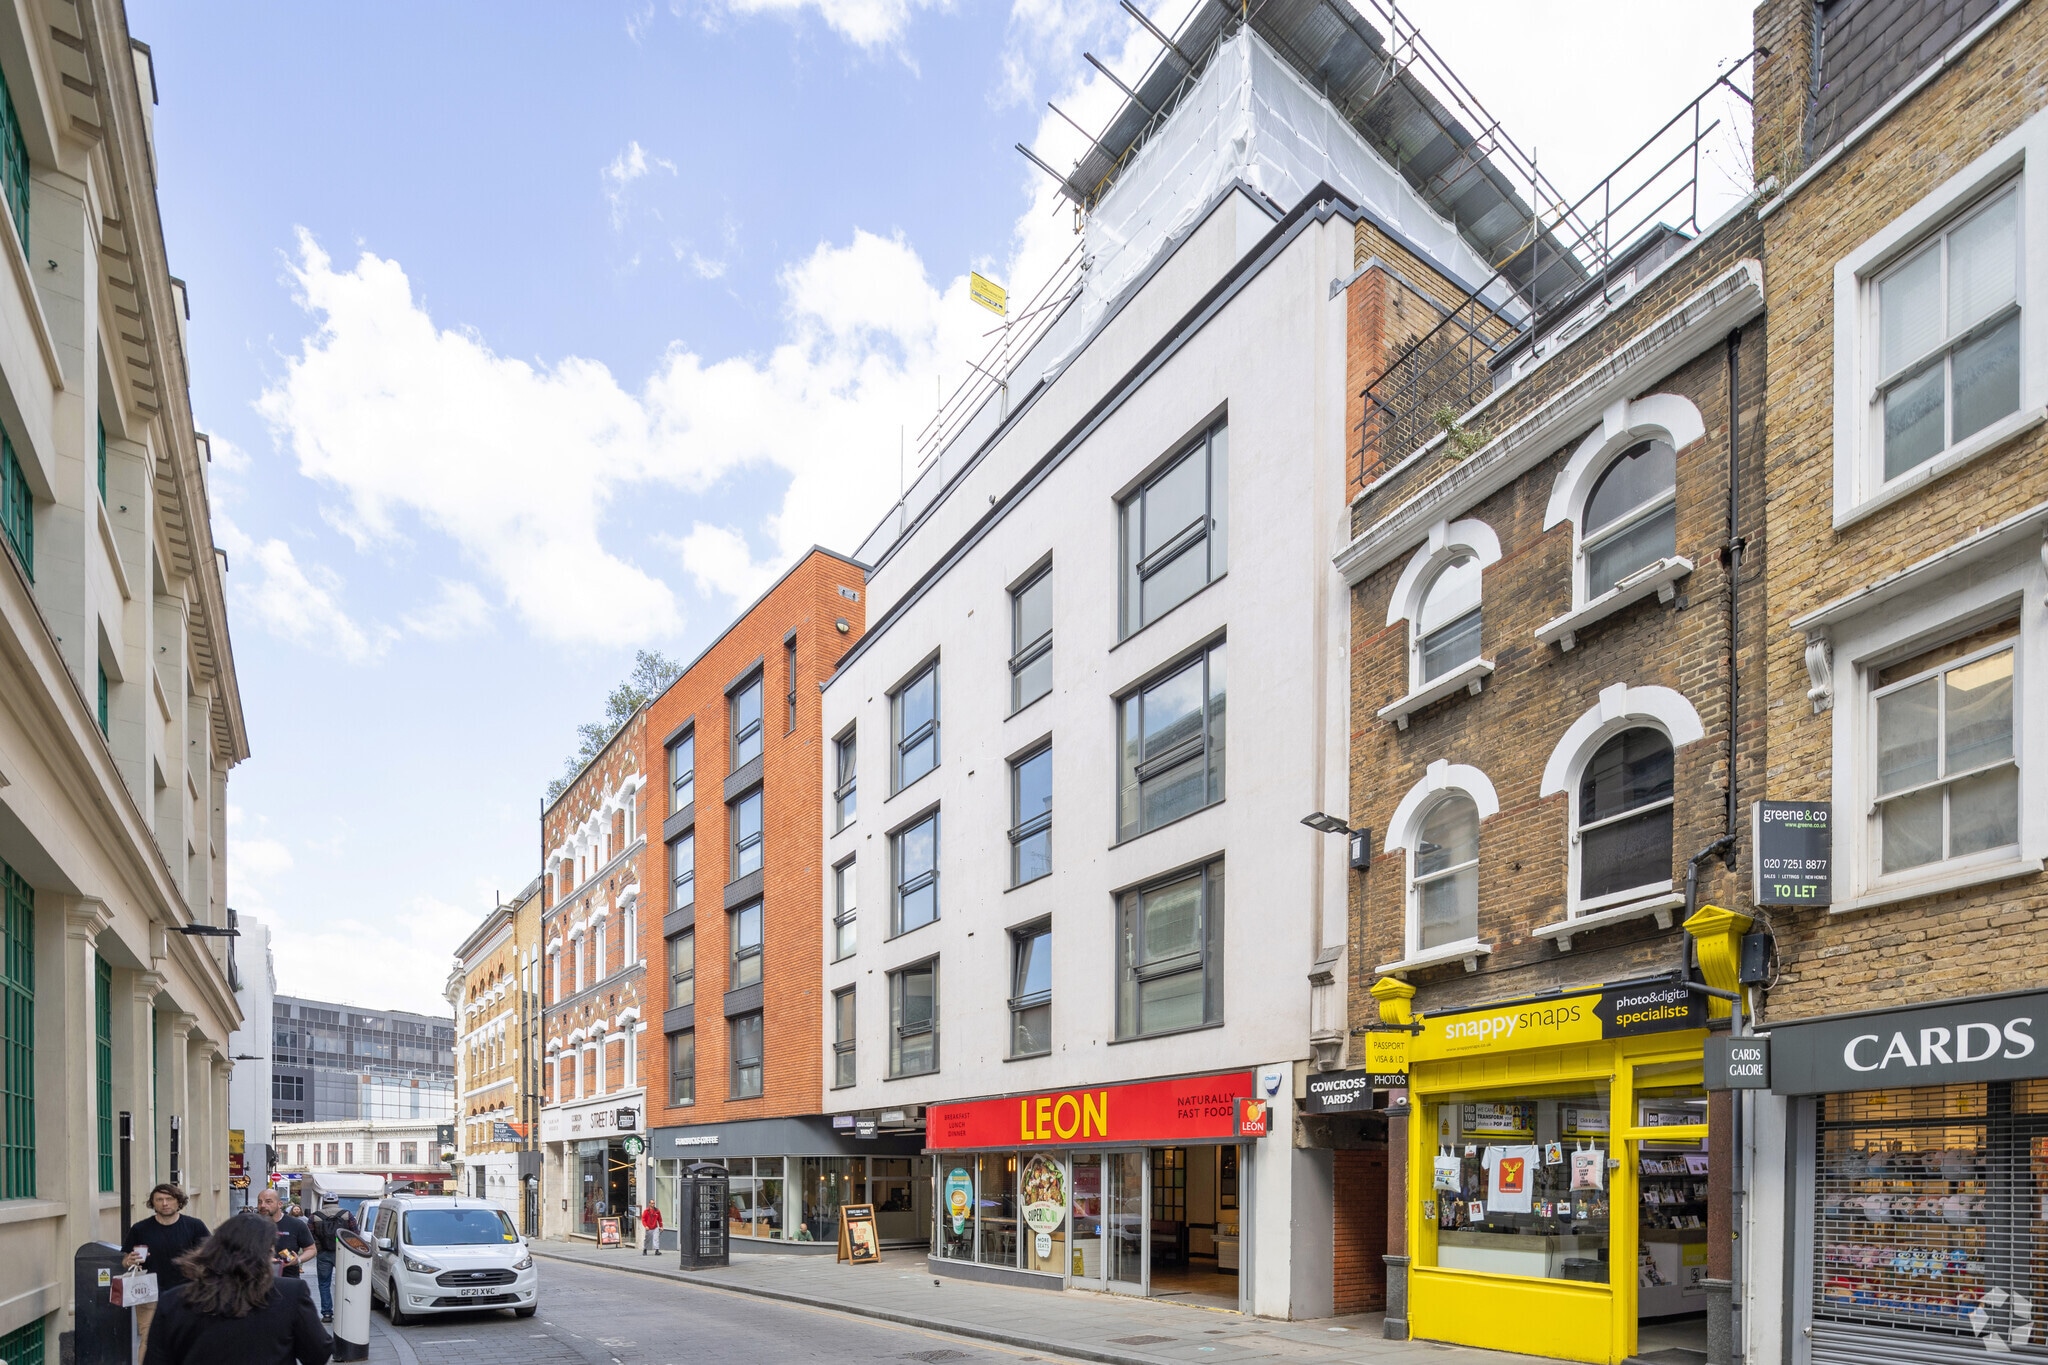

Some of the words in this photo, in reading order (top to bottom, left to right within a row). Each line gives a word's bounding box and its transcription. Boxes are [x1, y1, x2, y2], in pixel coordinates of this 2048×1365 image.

[1763, 809, 1827, 823] greene&co
[1763, 859, 1780, 869] 020
[1783, 859, 1803, 869] 7251
[1805, 860, 1827, 870] 8877
[1773, 884, 1791, 898] TO
[1794, 885, 1818, 898] LET
[1616, 988, 1689, 1010] photo&digital
[1616, 1004, 1689, 1027] specialists
[1373, 1042, 1405, 1050] PASSPORT
[1843, 1017, 2036, 1072] CARDS
[1374, 1055, 1388, 1063] VISA
[1731, 1048, 1761, 1061] CARDS
[1729, 1063, 1763, 1077] GALORE
[1310, 1077, 1367, 1093] COWCROSS
[1374, 1074, 1406, 1085] PHOTOS
[1177, 1092, 1236, 1106] NATURALLY
[1021, 1091, 1108, 1140] LEON
[1178, 1108, 1201, 1119] FAST
[1204, 1106, 1233, 1118] FOOD
[1464, 1105, 1475, 1113] DID
[944, 1112, 971, 1121] BREAKFAST
[948, 1121, 966, 1129] LUNCH
[1242, 1121, 1264, 1131] LEON
